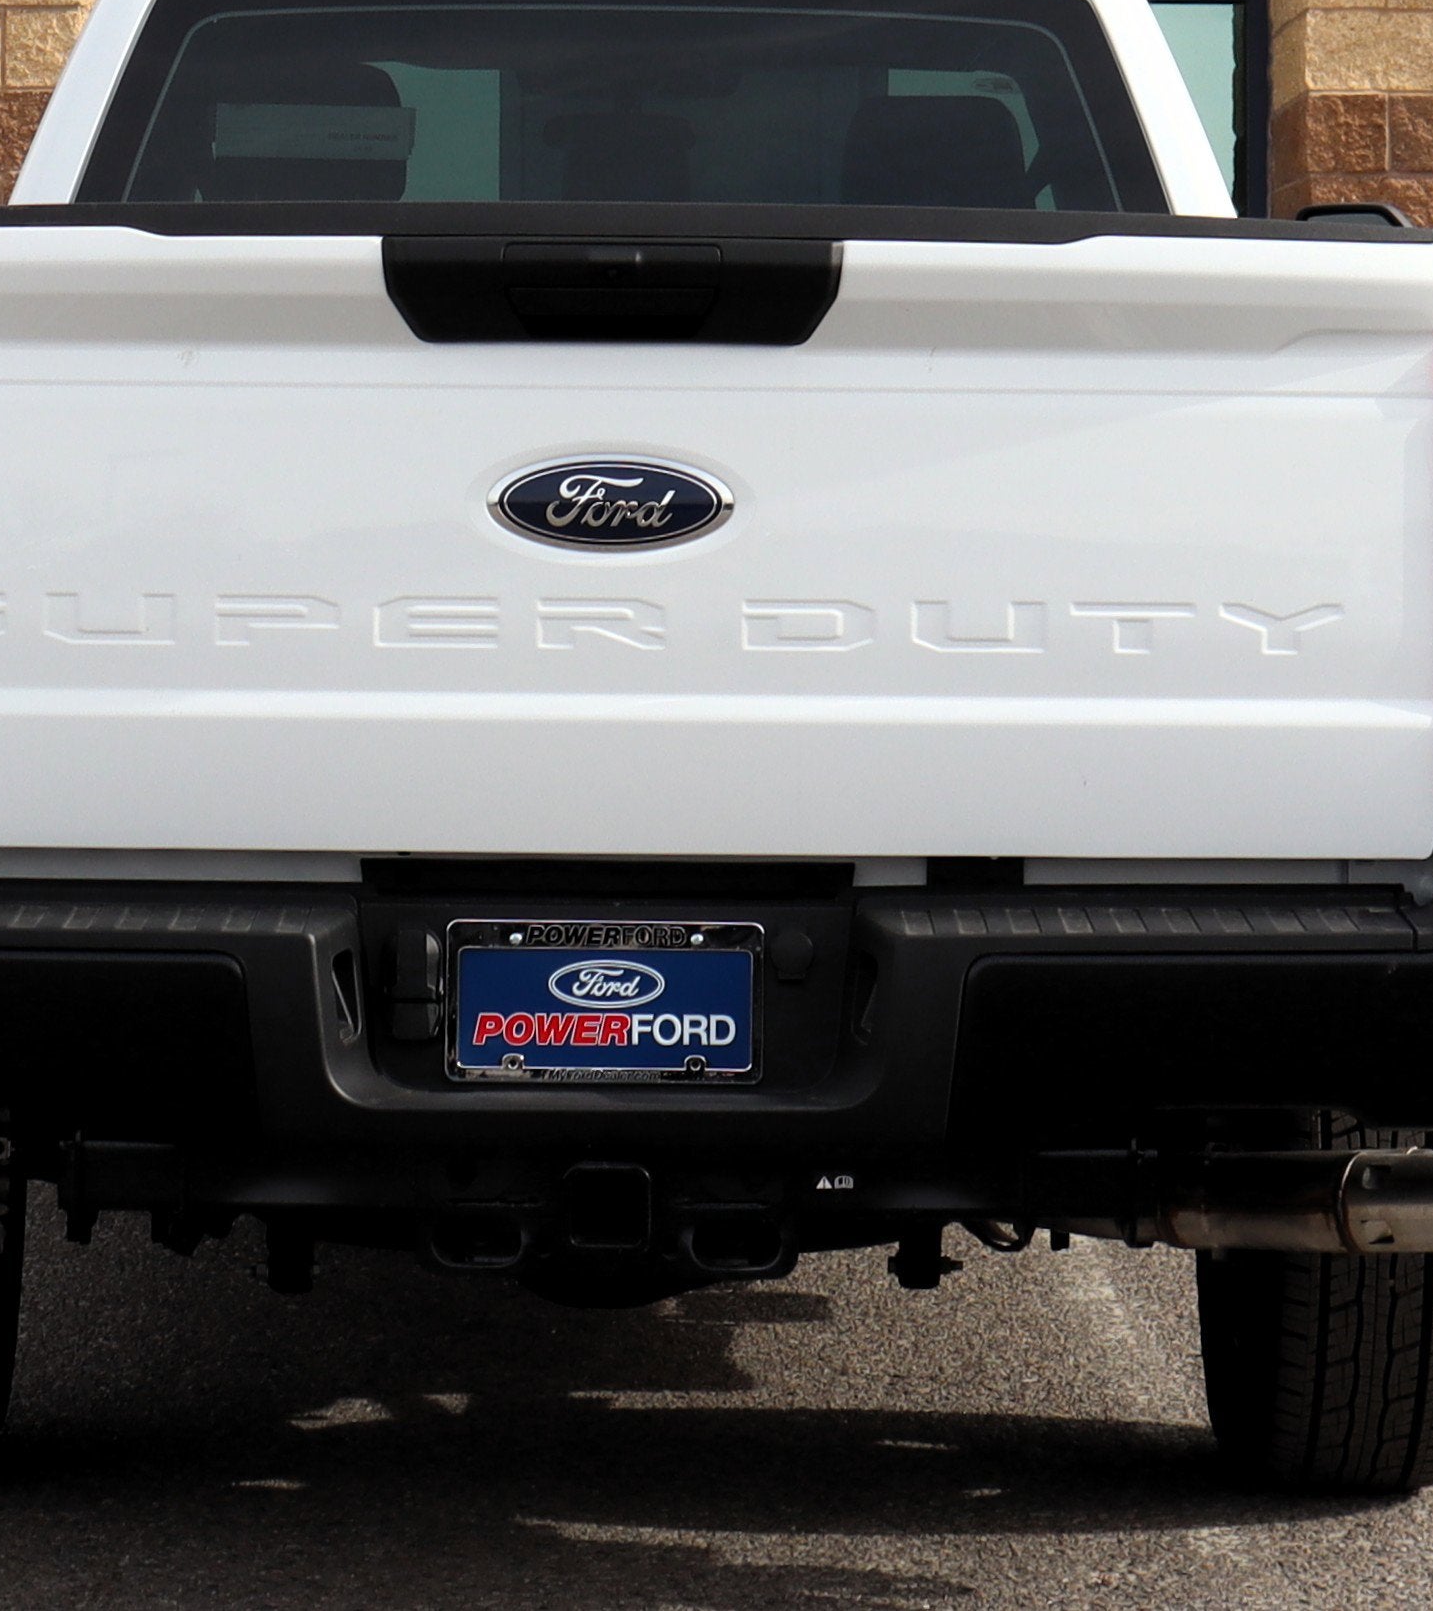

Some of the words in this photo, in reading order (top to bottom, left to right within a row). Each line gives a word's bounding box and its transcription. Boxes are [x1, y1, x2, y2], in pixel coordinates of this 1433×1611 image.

[545, 474, 676, 528] Ford
[742, 597, 1345, 656] DUTY
[525, 925, 687, 947] POWERFORD
[571, 968, 641, 998] Ford
[472, 1011, 737, 1047] POWERFORD
